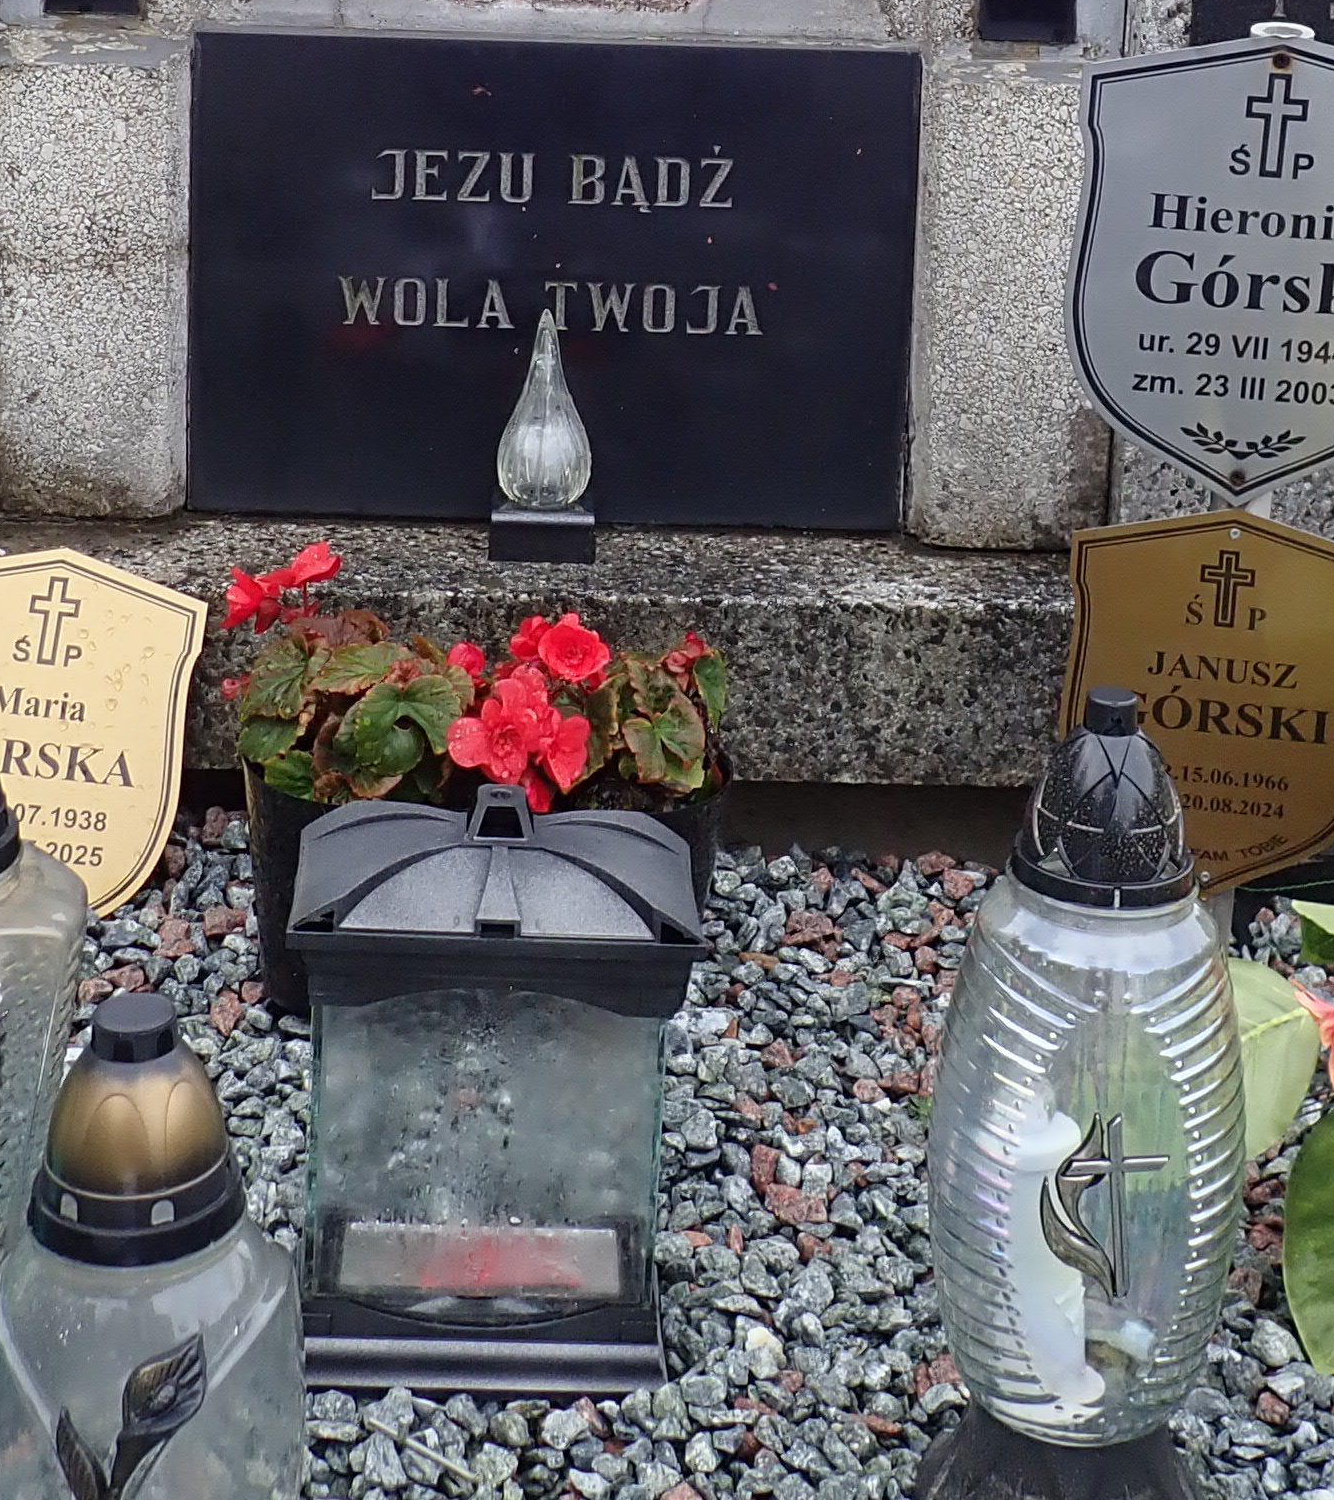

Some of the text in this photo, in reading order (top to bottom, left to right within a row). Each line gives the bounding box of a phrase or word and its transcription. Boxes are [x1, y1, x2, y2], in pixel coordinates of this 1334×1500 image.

[371, 148, 536, 204] JEZU
[1229, 144, 1315, 179] Ś P
[339, 275, 763, 336] WOLA TWOJA
[1138, 332, 1174, 354] ur.
[1186, 332, 1220, 357] 29
[1232, 335, 1269, 360] VII
[1132, 373, 1184, 395] zm.
[1195, 373, 1229, 398] 23
[1241, 377, 1266, 401] III
[1185, 594, 1267, 631] Ś P
[12, 635, 82, 668] Ś P
[1147, 650, 1298, 690] JANUSZ
[1235, 833, 1289, 859] TOBIE
